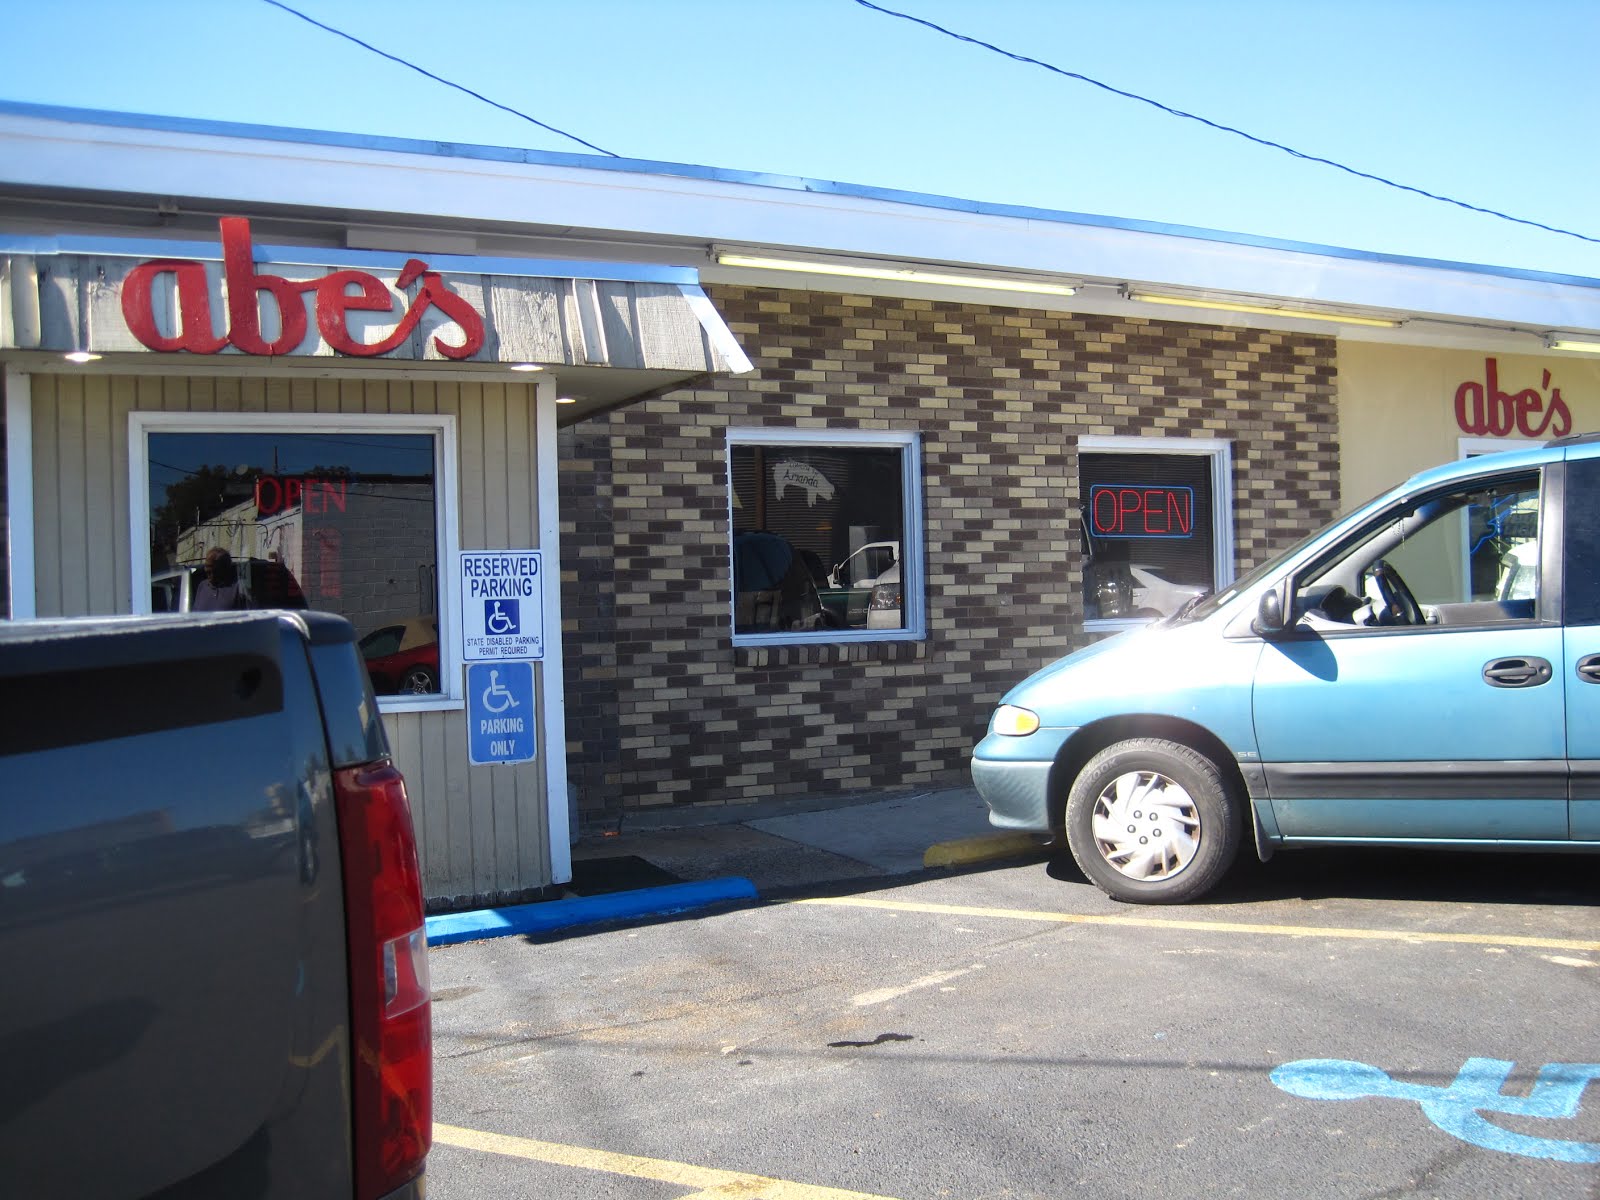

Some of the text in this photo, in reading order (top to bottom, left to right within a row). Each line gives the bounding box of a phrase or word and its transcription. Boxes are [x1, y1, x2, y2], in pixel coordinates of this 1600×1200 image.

[121, 217, 484, 359] abe's
[1454, 357, 1572, 438] abe's
[783, 469, 819, 489] Amanda
[254, 476, 346, 514] OPEN
[1094, 489, 1190, 533] OPEN
[464, 557, 538, 577] RESERVED
[471, 578, 532, 598] PARKING
[466, 636, 539, 647] STATE DISABLED PARKING
[478, 646, 527, 656] PERMIT REQUIRED
[480, 718, 524, 735] PARKING
[490, 739, 516, 756] ONLY
